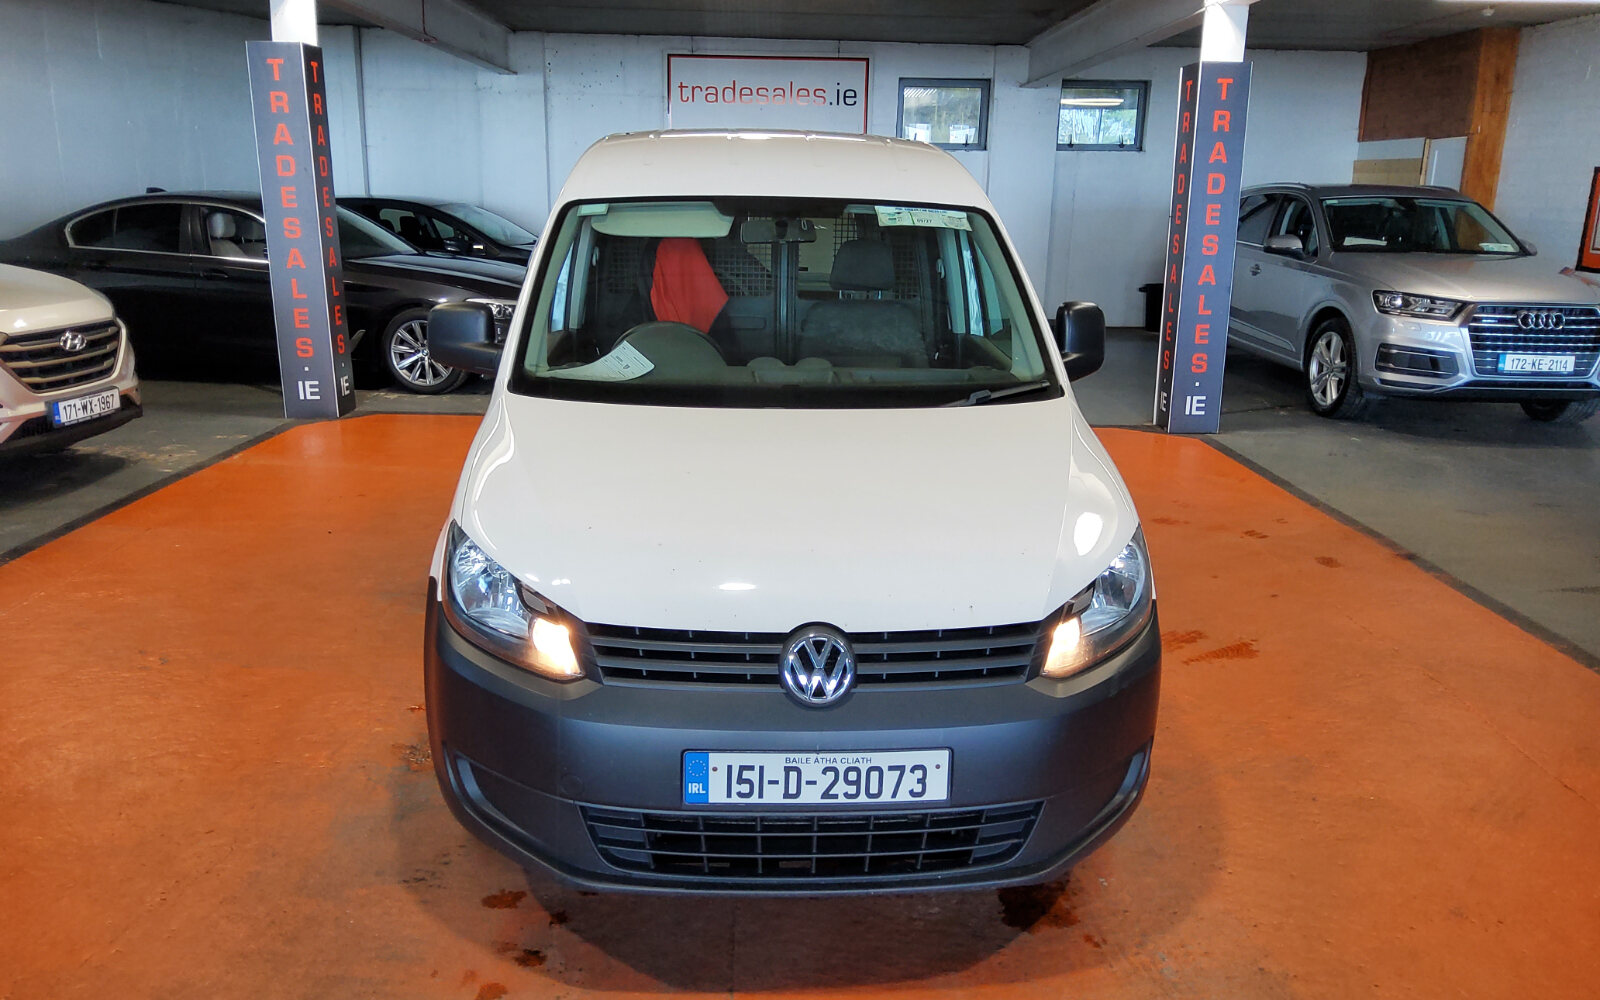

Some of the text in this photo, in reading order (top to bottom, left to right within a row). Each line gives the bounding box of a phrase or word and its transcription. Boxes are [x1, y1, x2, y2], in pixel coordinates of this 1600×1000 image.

[677, 79, 858, 107] tradesales.ie
[1510, 357, 1569, 372] 172-KE-2114
[62, 393, 116, 421] 171-WX-1967
[688, 783, 706, 794] IRL
[726, 763, 928, 800] 151-D-29073
